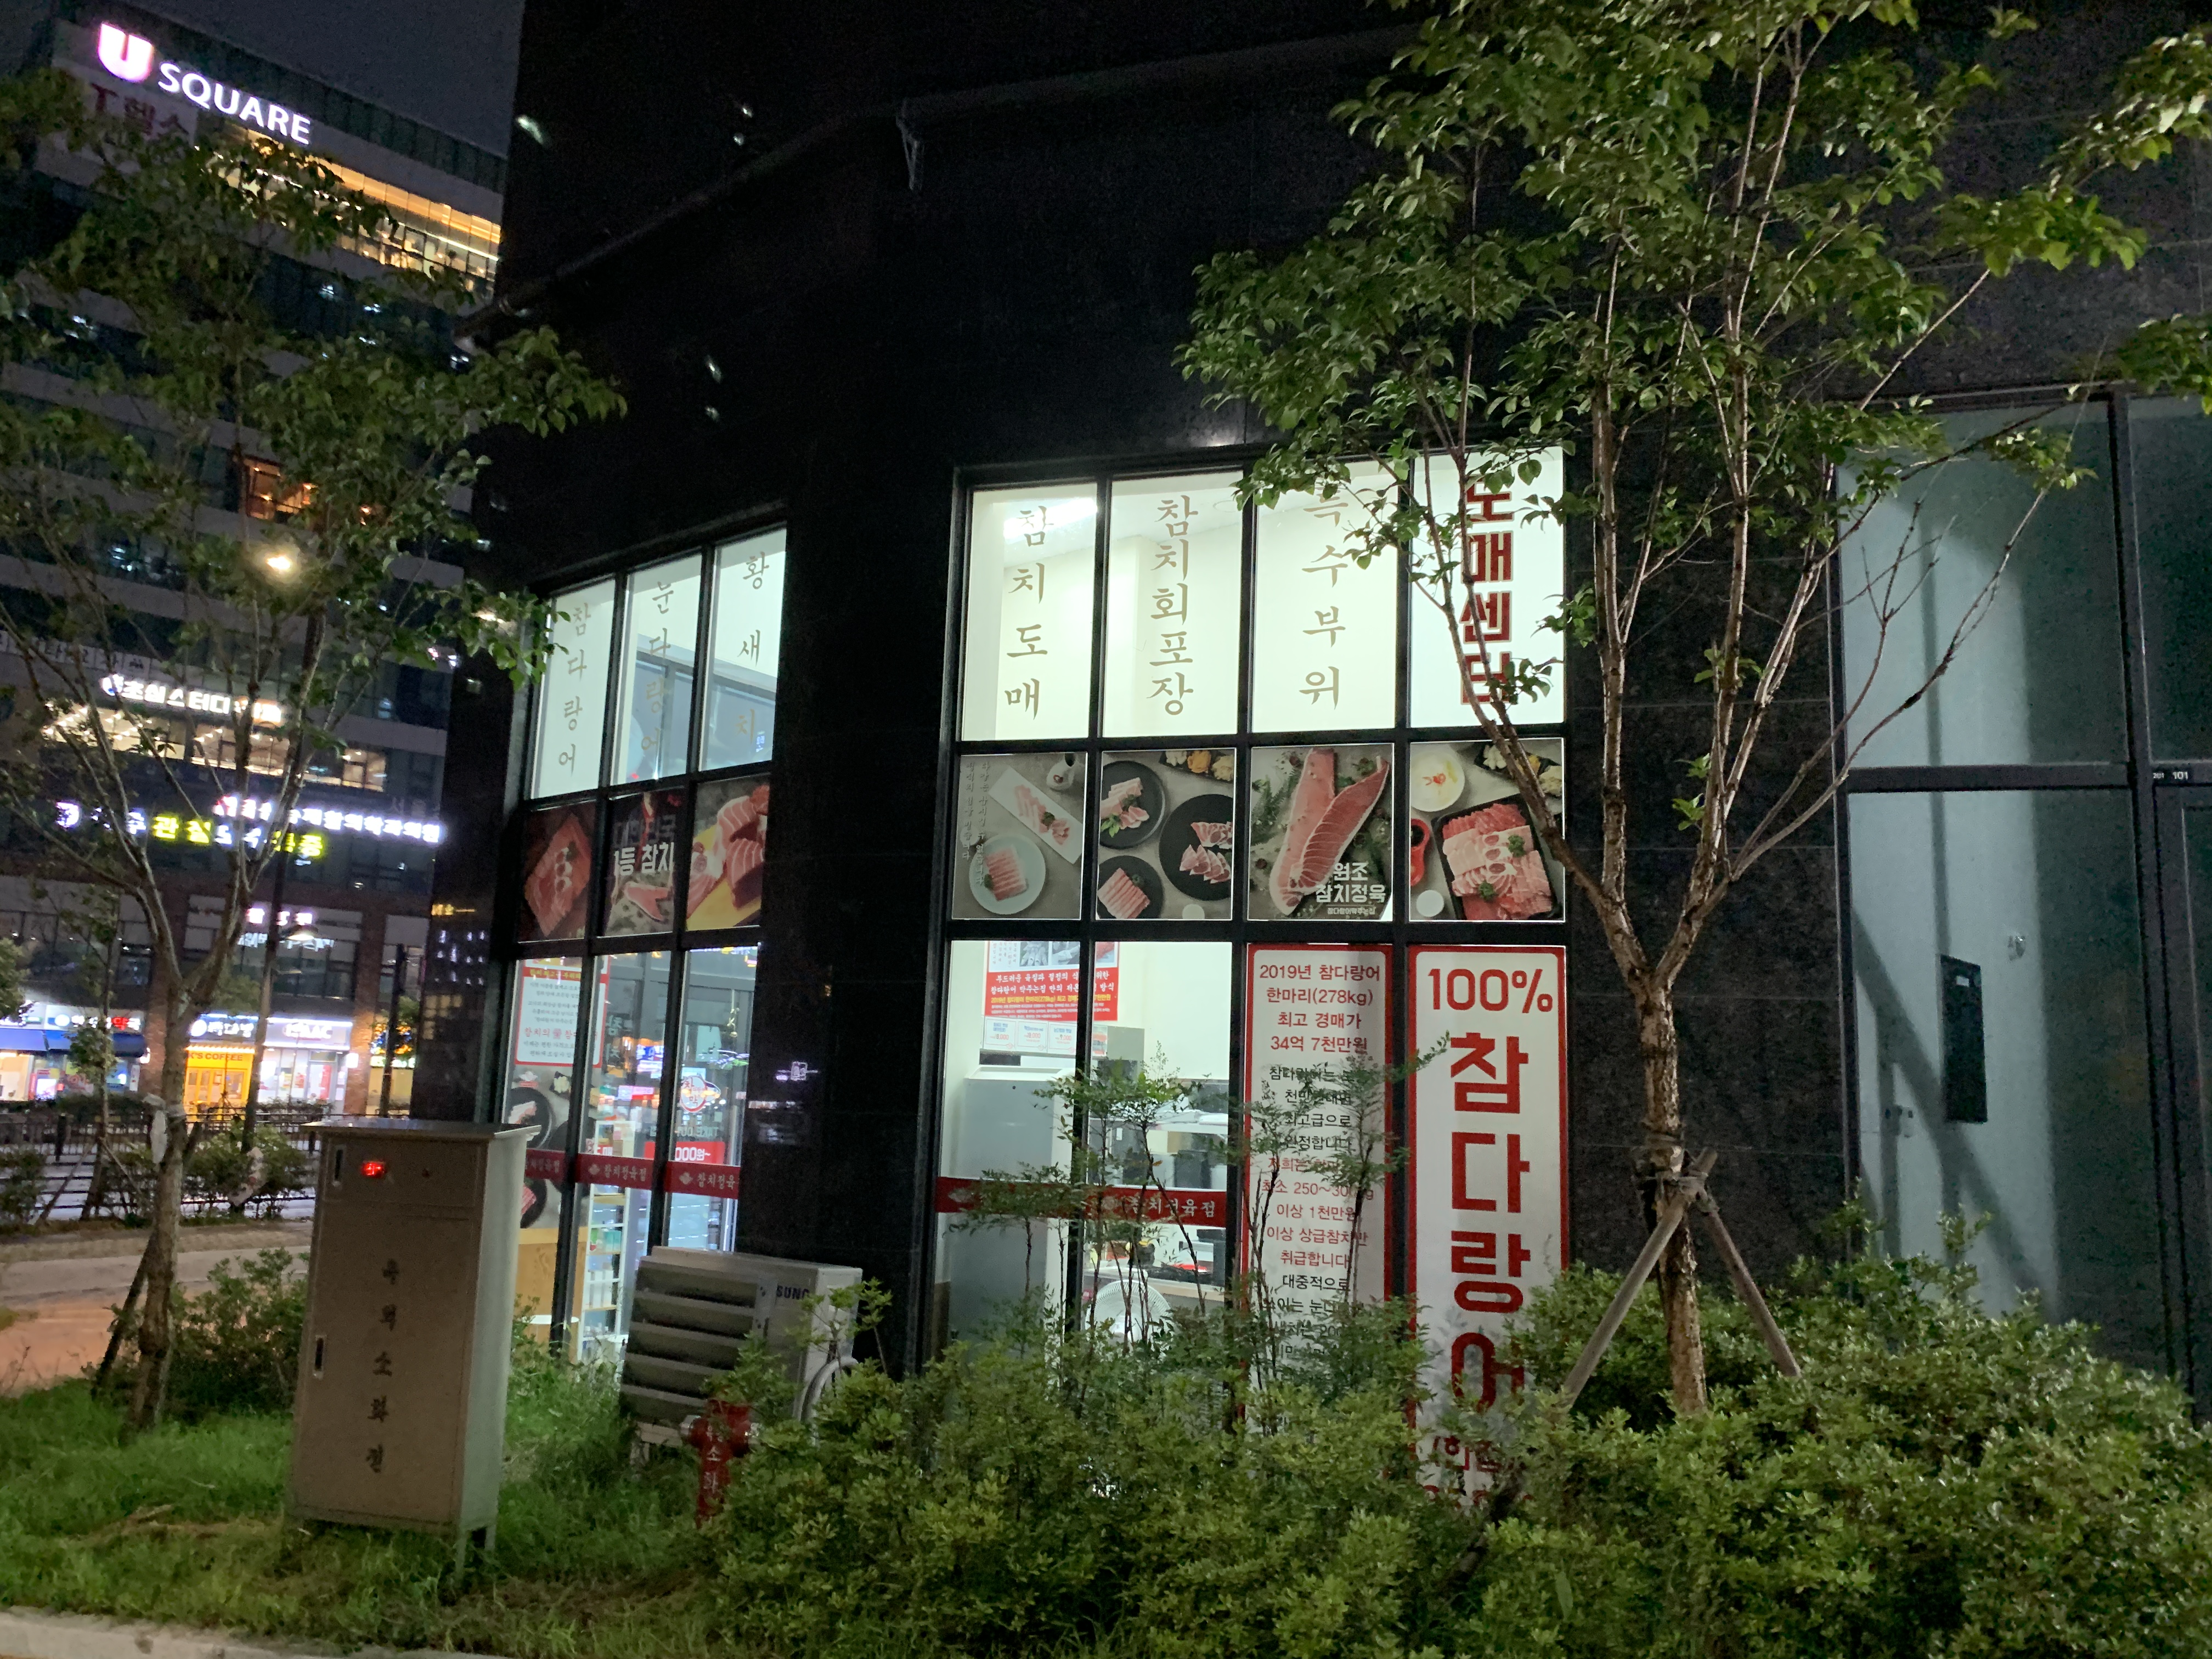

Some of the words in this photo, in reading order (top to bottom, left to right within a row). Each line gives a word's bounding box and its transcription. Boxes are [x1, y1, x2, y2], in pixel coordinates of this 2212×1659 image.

[158, 62, 311, 144] SQUARE
[1299, 486, 1349, 710] 특수부위
[1460, 476, 1515, 705] 도매센터
[1004, 505, 1054, 720] 참치도매
[1146, 495, 1198, 715] 참치회포장
[735, 551, 770, 744] 황새치
[640, 581, 675, 752] 눈다랑어
[558, 602, 592, 776] 참다랑어
[2172, 771, 2188, 780] 101
[614, 847, 636, 876] 1등
[642, 842, 674, 873] 참치
[1333, 862, 1368, 881] 원조
[1316, 884, 1386, 902] 참치정육
[1260, 965, 1311, 979] 2019년
[1319, 965, 1380, 981] 참다랑어
[1266, 988, 1373, 1006] 한마리(278kg)
[1428, 969, 1553, 1013] 100%
[1278, 1012, 1308, 1027] 최고
[1316, 1013, 1362, 1029] 경매가
[1271, 1036, 1304, 1051] 34억
[1311, 1036, 1368, 1054] 7천만원
[205, 1053, 243, 1061] COFFEE
[603, 1164, 647, 1182] 참치정육점
[696, 1172, 738, 1190] 참치정육
[1277, 1204, 1303, 1219] 이상
[1451, 1032, 1531, 1413] 참다랑어
[1267, 1226, 1294, 1242] 이상
[1280, 1249, 1350, 1268] 취급합니다
[1282, 1274, 1351, 1291] 대중적으로
